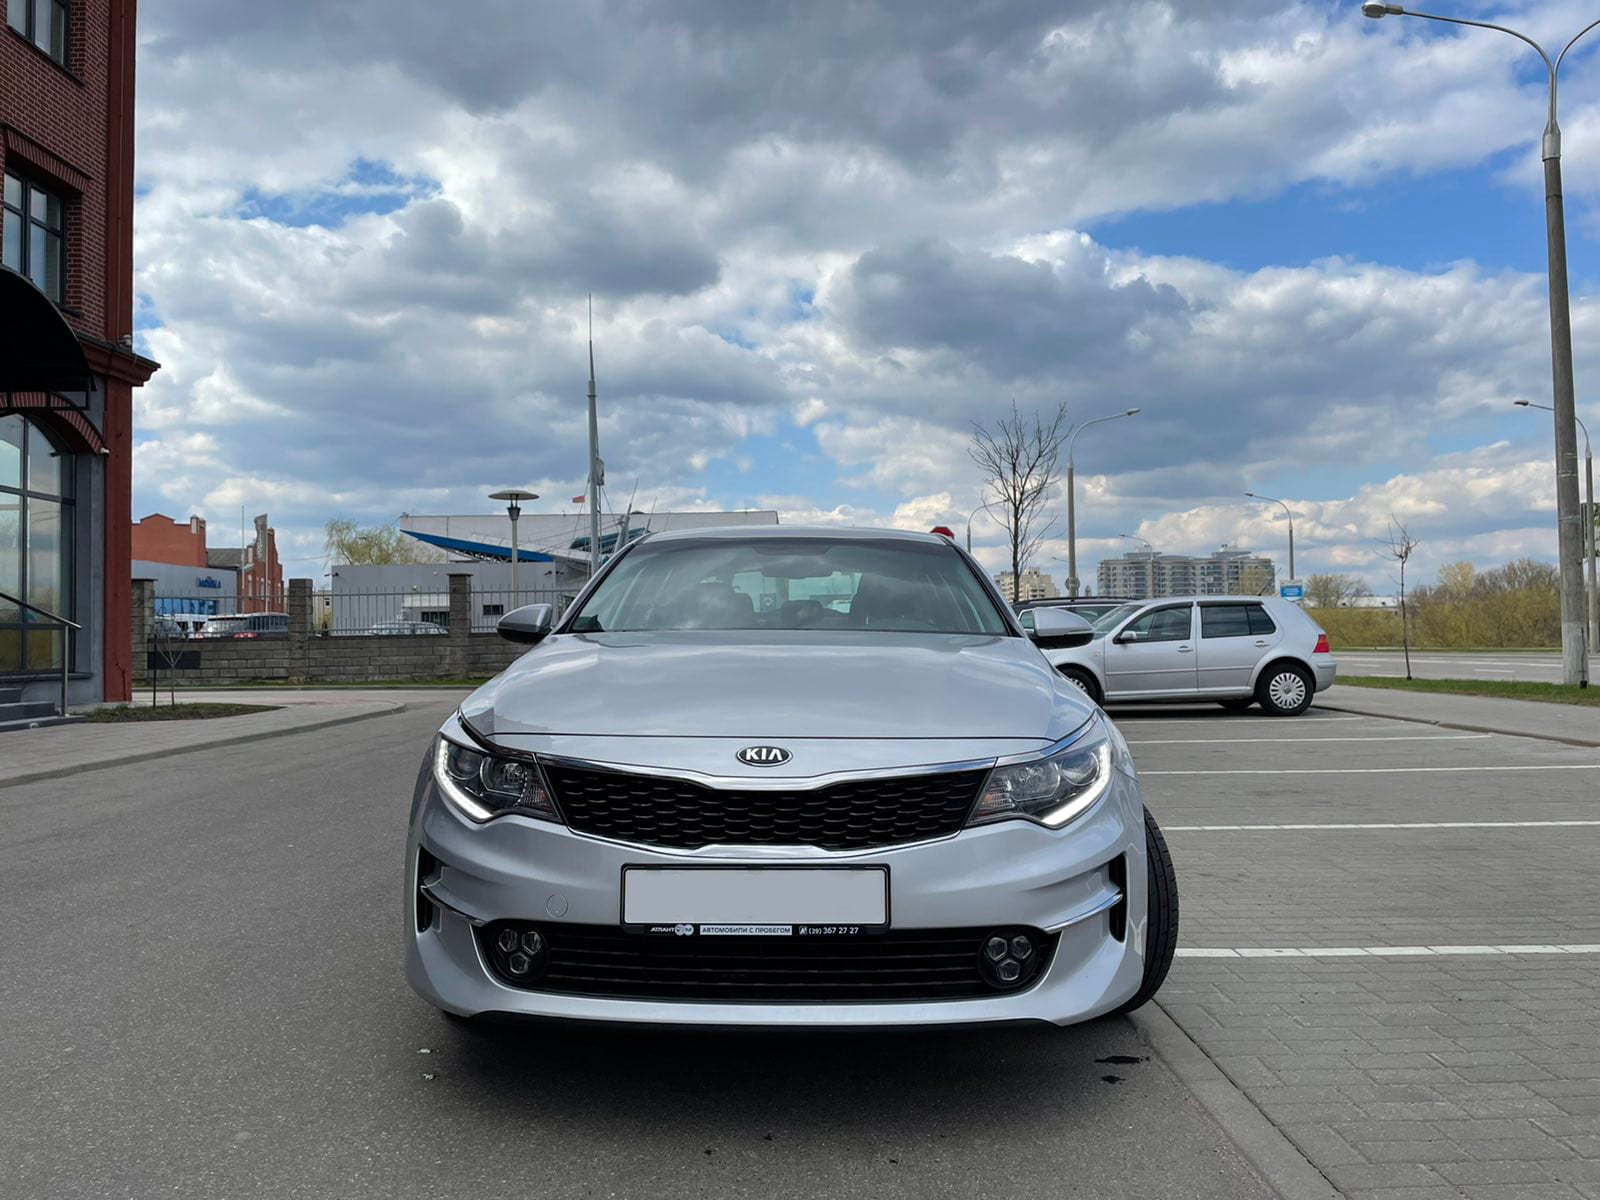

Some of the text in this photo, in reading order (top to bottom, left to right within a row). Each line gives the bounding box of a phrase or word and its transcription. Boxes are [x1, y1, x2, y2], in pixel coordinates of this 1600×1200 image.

[745, 747, 783, 761] KIA
[702, 926, 791, 934] АВТОМОБИЛИ С ПРОБЕГОМ
[823, 926, 837, 935] 367
[838, 926, 848, 935] 27
[849, 926, 859, 935] 27
